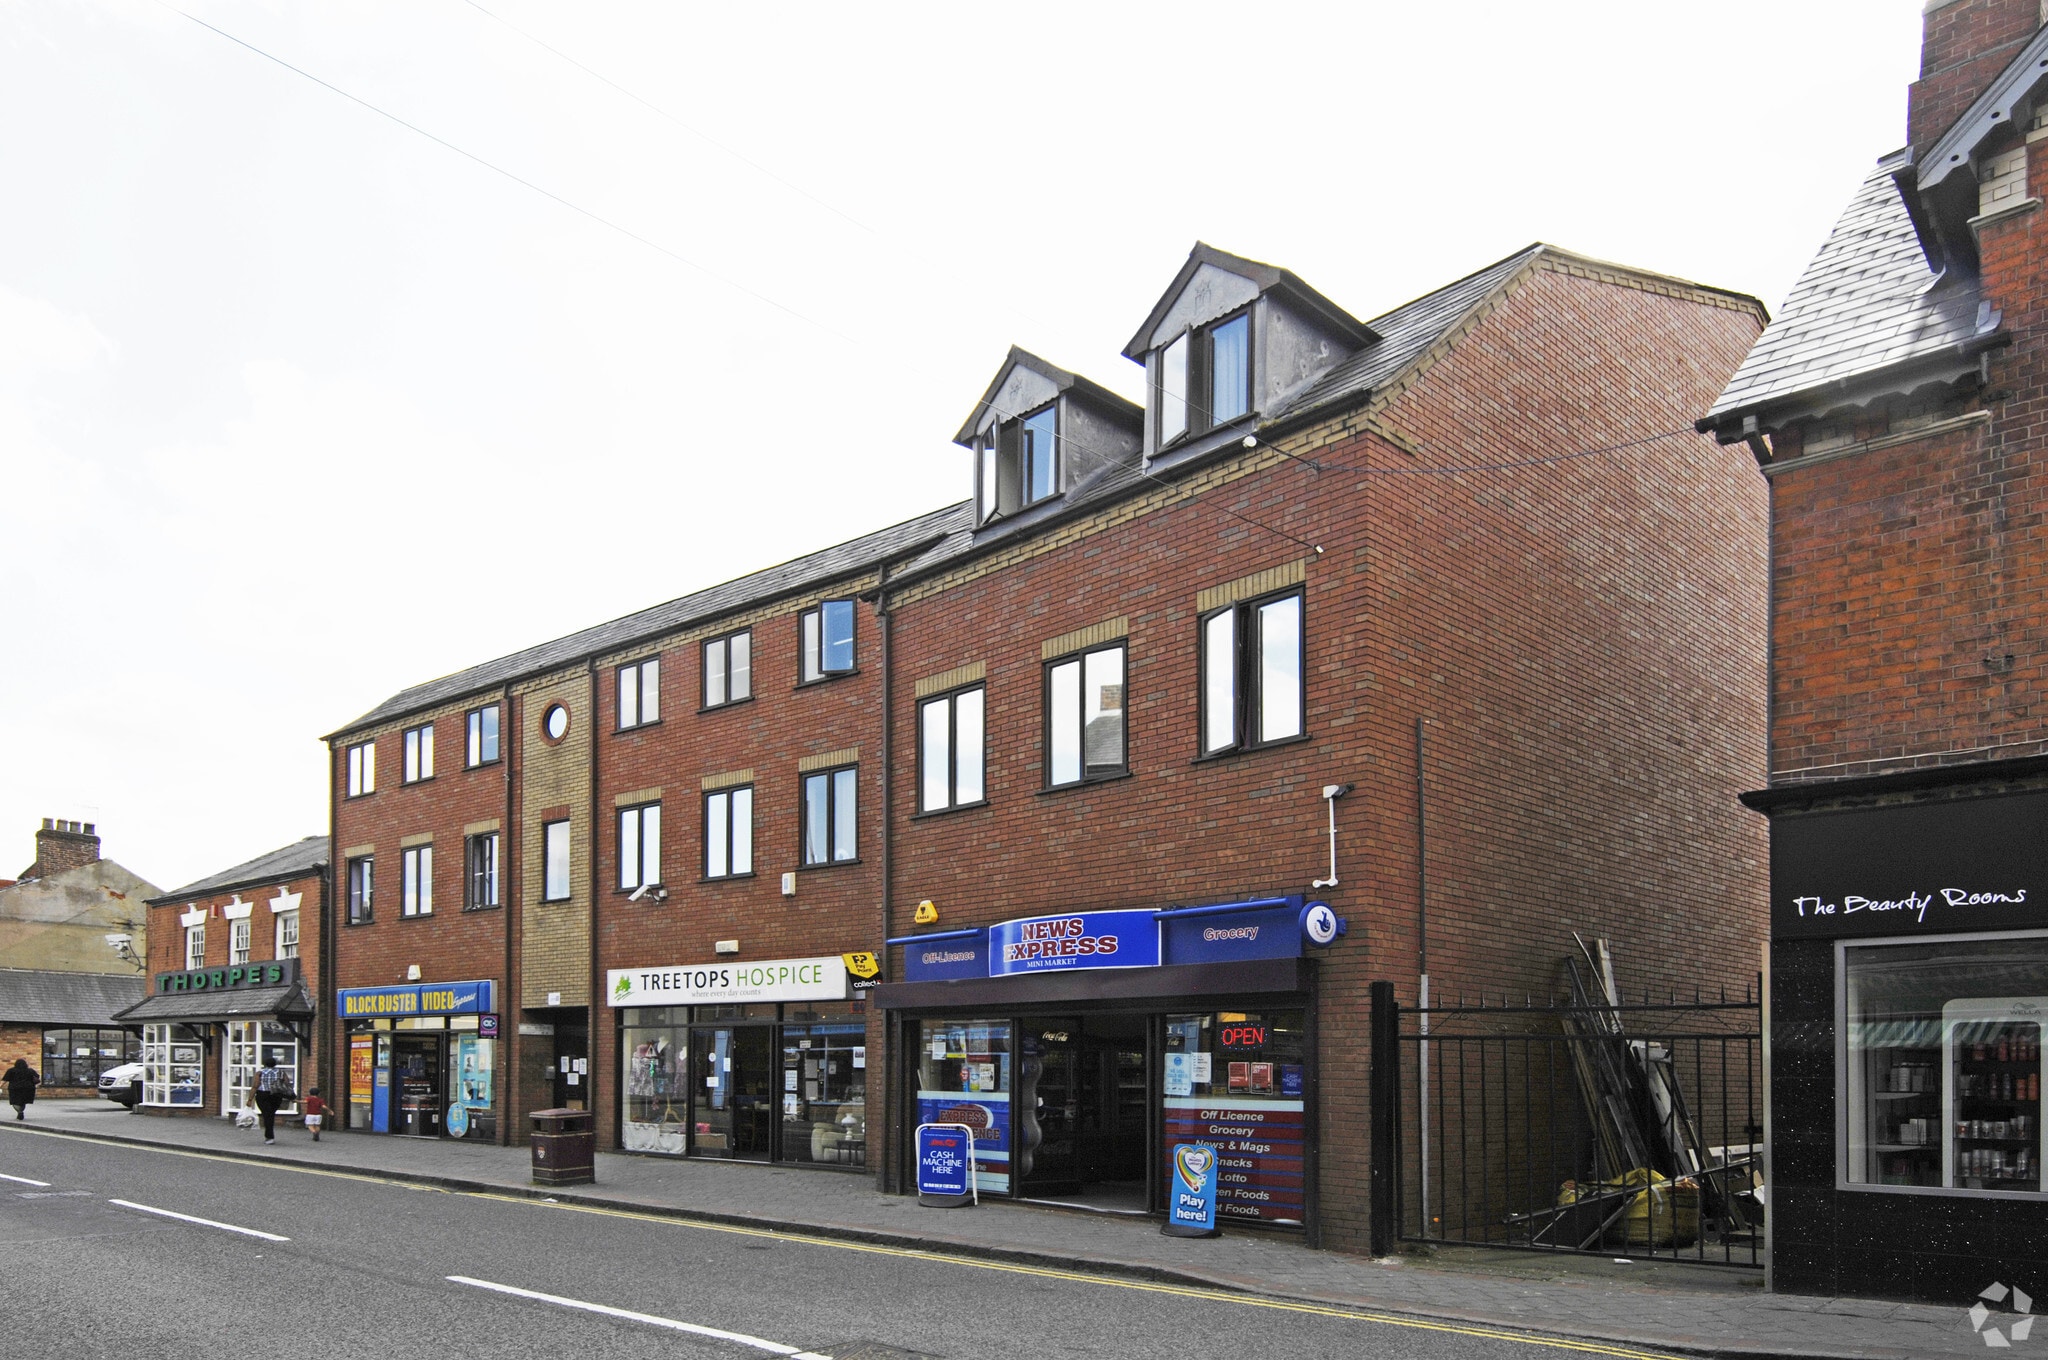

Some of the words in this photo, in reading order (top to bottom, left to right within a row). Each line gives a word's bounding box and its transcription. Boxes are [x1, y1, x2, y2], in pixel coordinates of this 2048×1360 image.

[1793, 896, 1836, 917] The
[1843, 891, 1931, 922] Beauty
[1940, 888, 2027, 906] Rooms
[1021, 917, 1084, 941] NEWS
[1203, 926, 1259, 941] Grocery
[1003, 935, 1118, 963] EXPRESS
[922, 951, 976, 965] Off-Licence
[1044, 958, 1077, 967] MARKET
[157, 965, 282, 991] THORPES
[641, 970, 730, 991] TREETOPS
[736, 964, 823, 987] HOSPICE
[709, 990, 727, 998] every
[727, 988, 738, 997] day
[739, 988, 761, 996] counts
[346, 992, 417, 1014] BLOCKBUSTER
[422, 991, 454, 1010] VIDEO
[1222, 1027, 1265, 1045] OPEN
[939, 1109, 987, 1123] EXPRESS
[1200, 1110, 1219, 1120] Off
[1219, 1111, 1264, 1121] Licence
[1209, 1125, 1254, 1138] Grocery
[1228, 1141, 1237, 1150] &
[1239, 1142, 1271, 1154] Mags
[930, 1150, 954, 1159] CASH
[922, 1158, 962, 1167] MACHINE
[932, 1166, 953, 1174] HERE
[1217, 1172, 1247, 1183] Lotto
[1179, 1193, 1205, 1209] Play
[1234, 1189, 1270, 1201] Foods
[1176, 1208, 1207, 1221] here!
[1225, 1204, 1260, 1215] Foods
